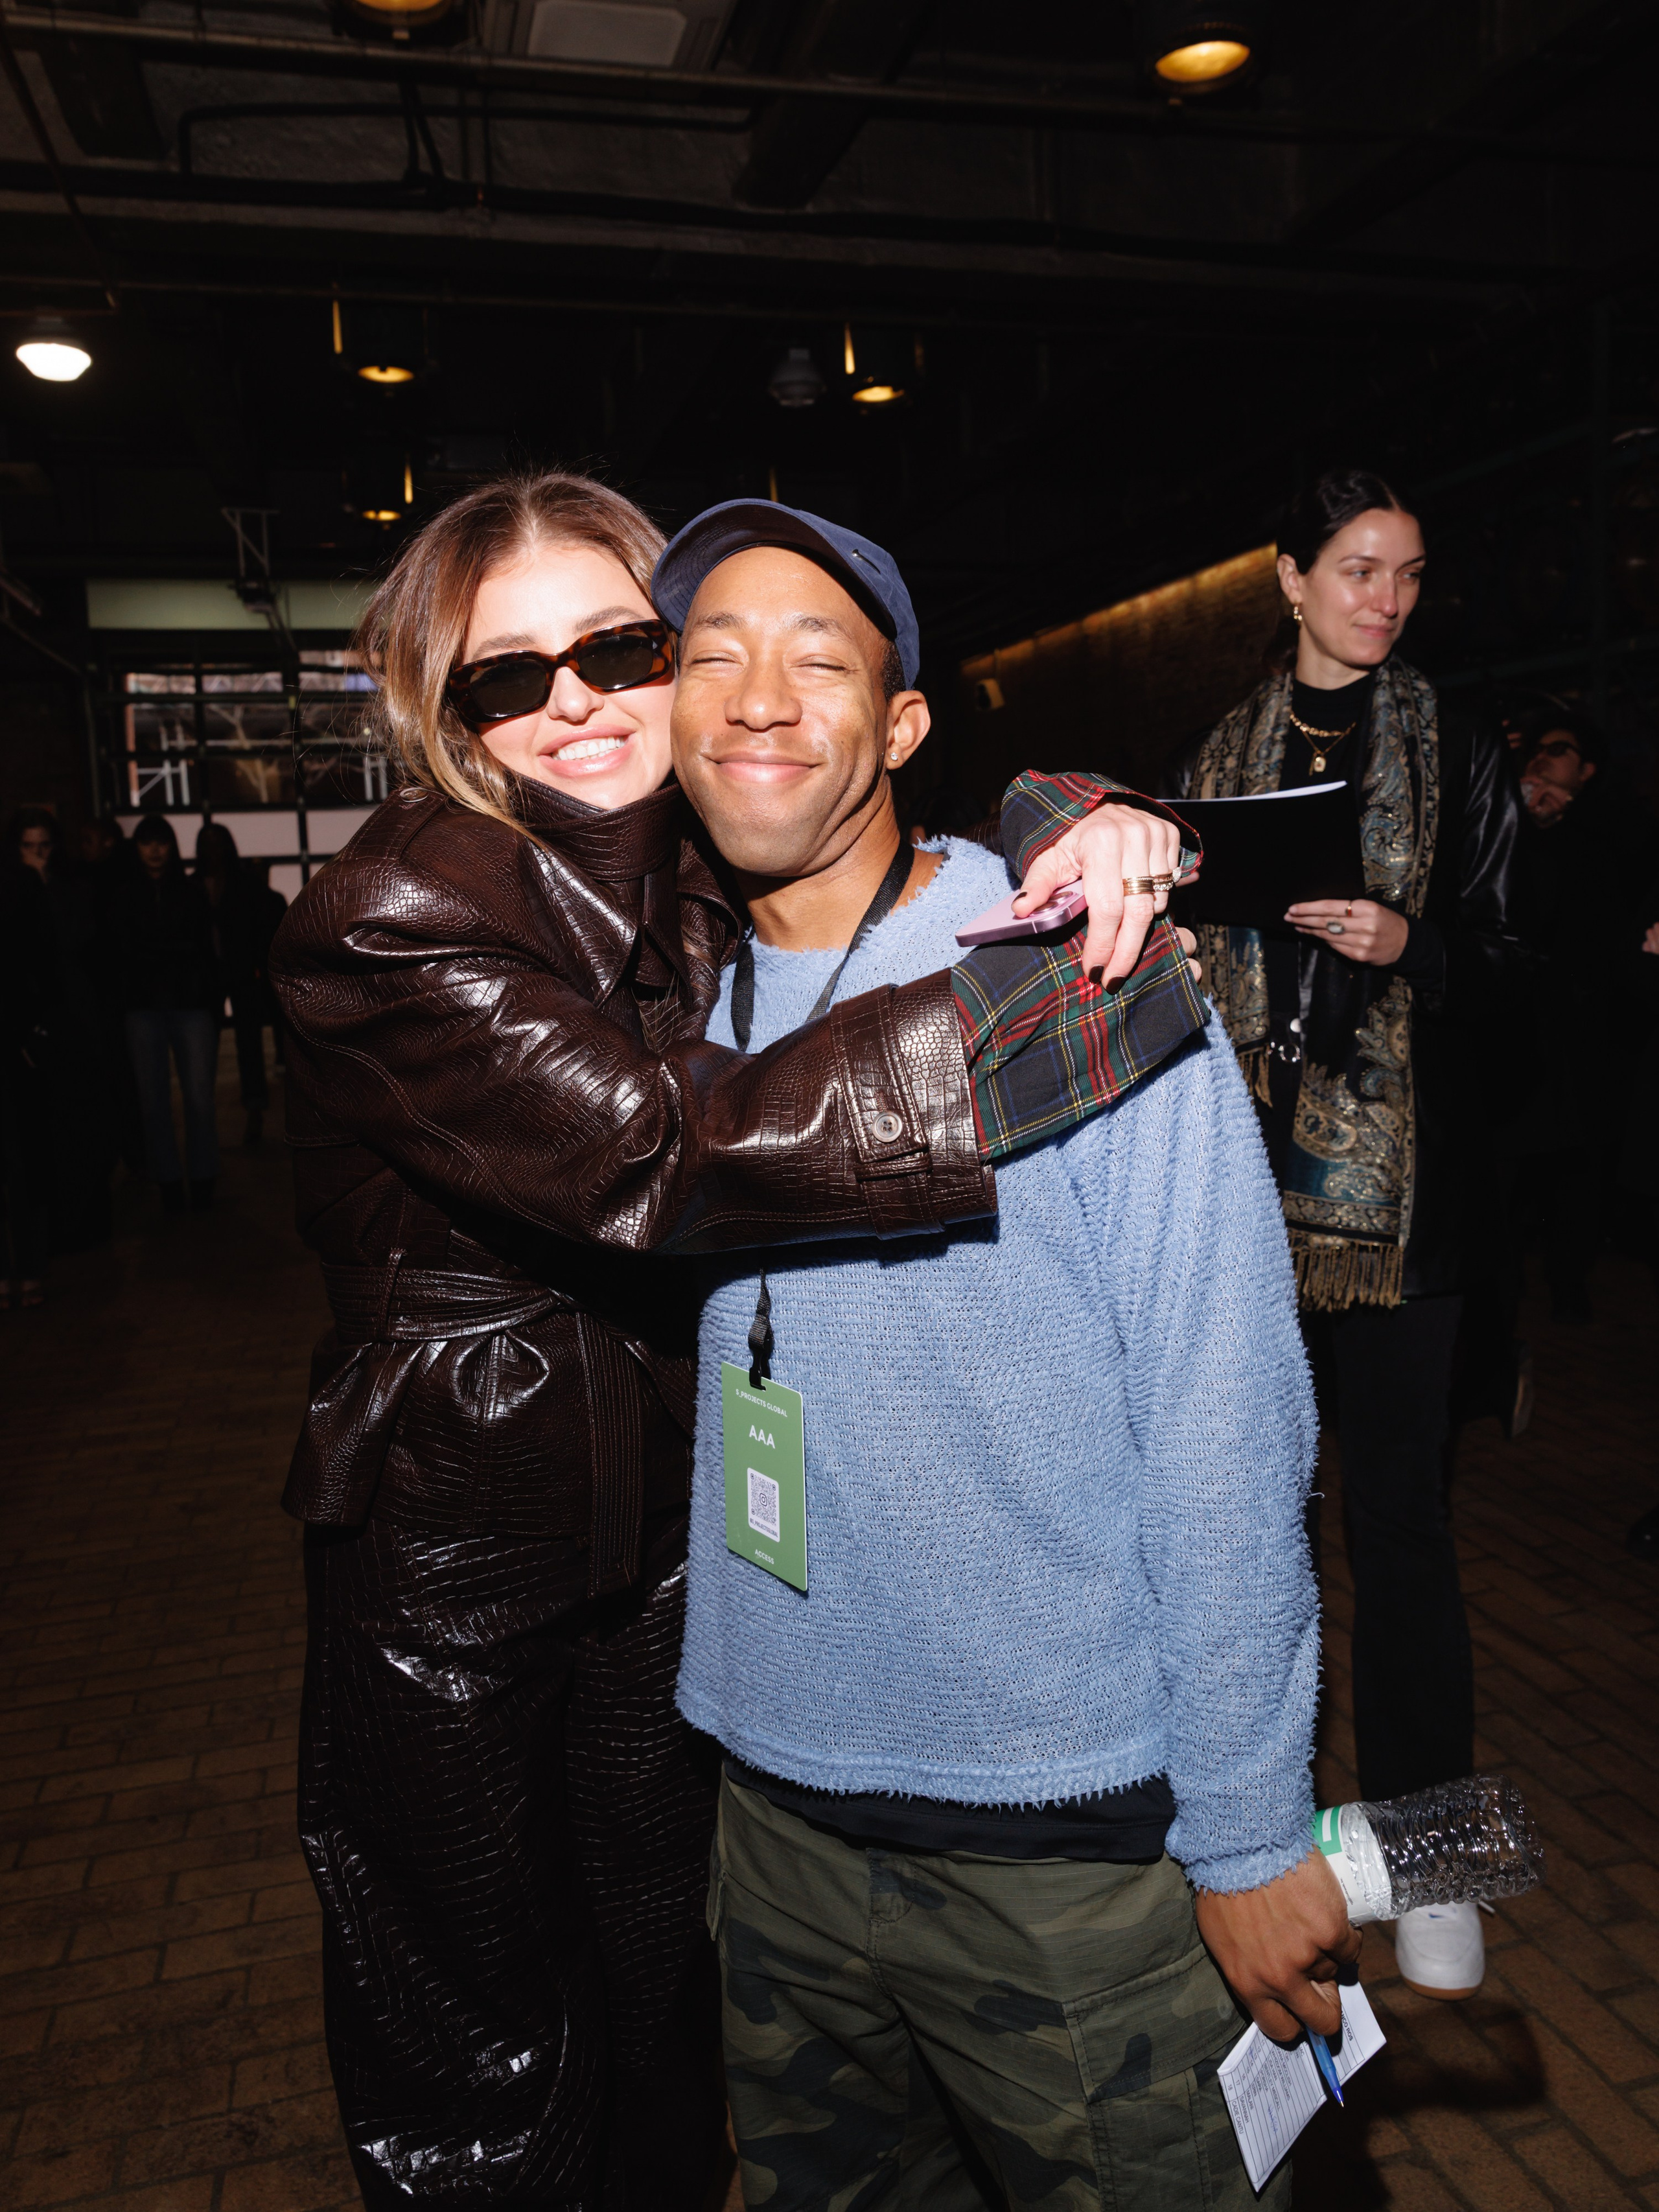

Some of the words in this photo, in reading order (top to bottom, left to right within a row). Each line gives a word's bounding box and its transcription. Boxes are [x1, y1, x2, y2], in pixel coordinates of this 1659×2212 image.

[736, 1388, 767, 1407] S_PROJECTS
[767, 1403, 788, 1417] GLOBAL
[748, 1425, 776, 1449] AAA
[754, 1548, 774, 1565] ACCESS
[1231, 2101, 1240, 2117] CADIE
[1239, 2095, 1249, 2124] SAVANNAH
[1246, 2090, 1255, 2110] MALANI
[1235, 2116, 1244, 2134] CANTU
